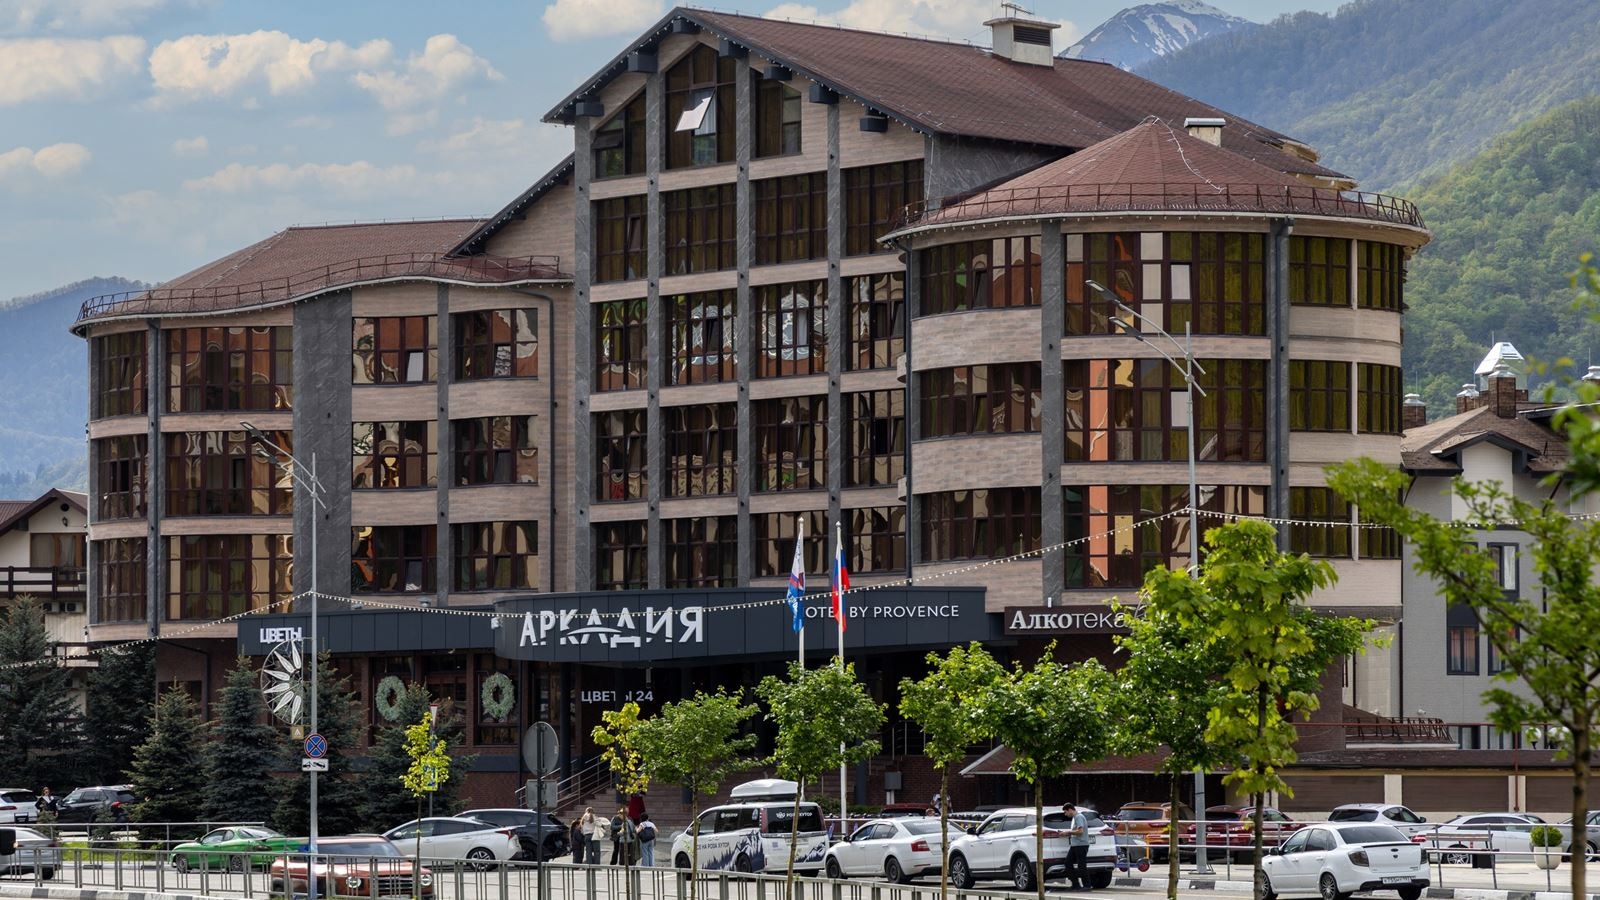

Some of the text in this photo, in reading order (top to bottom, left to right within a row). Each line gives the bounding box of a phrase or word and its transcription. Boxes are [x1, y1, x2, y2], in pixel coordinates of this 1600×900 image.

[804, 604, 960, 619] OTE BY PROVENCE
[1009, 610, 1129, 630] Алкотека
[260, 626, 303, 644] ЦВЕТЫ
[520, 606, 703, 648] АРКАДИЯ
[635, 691, 654, 701] 24
